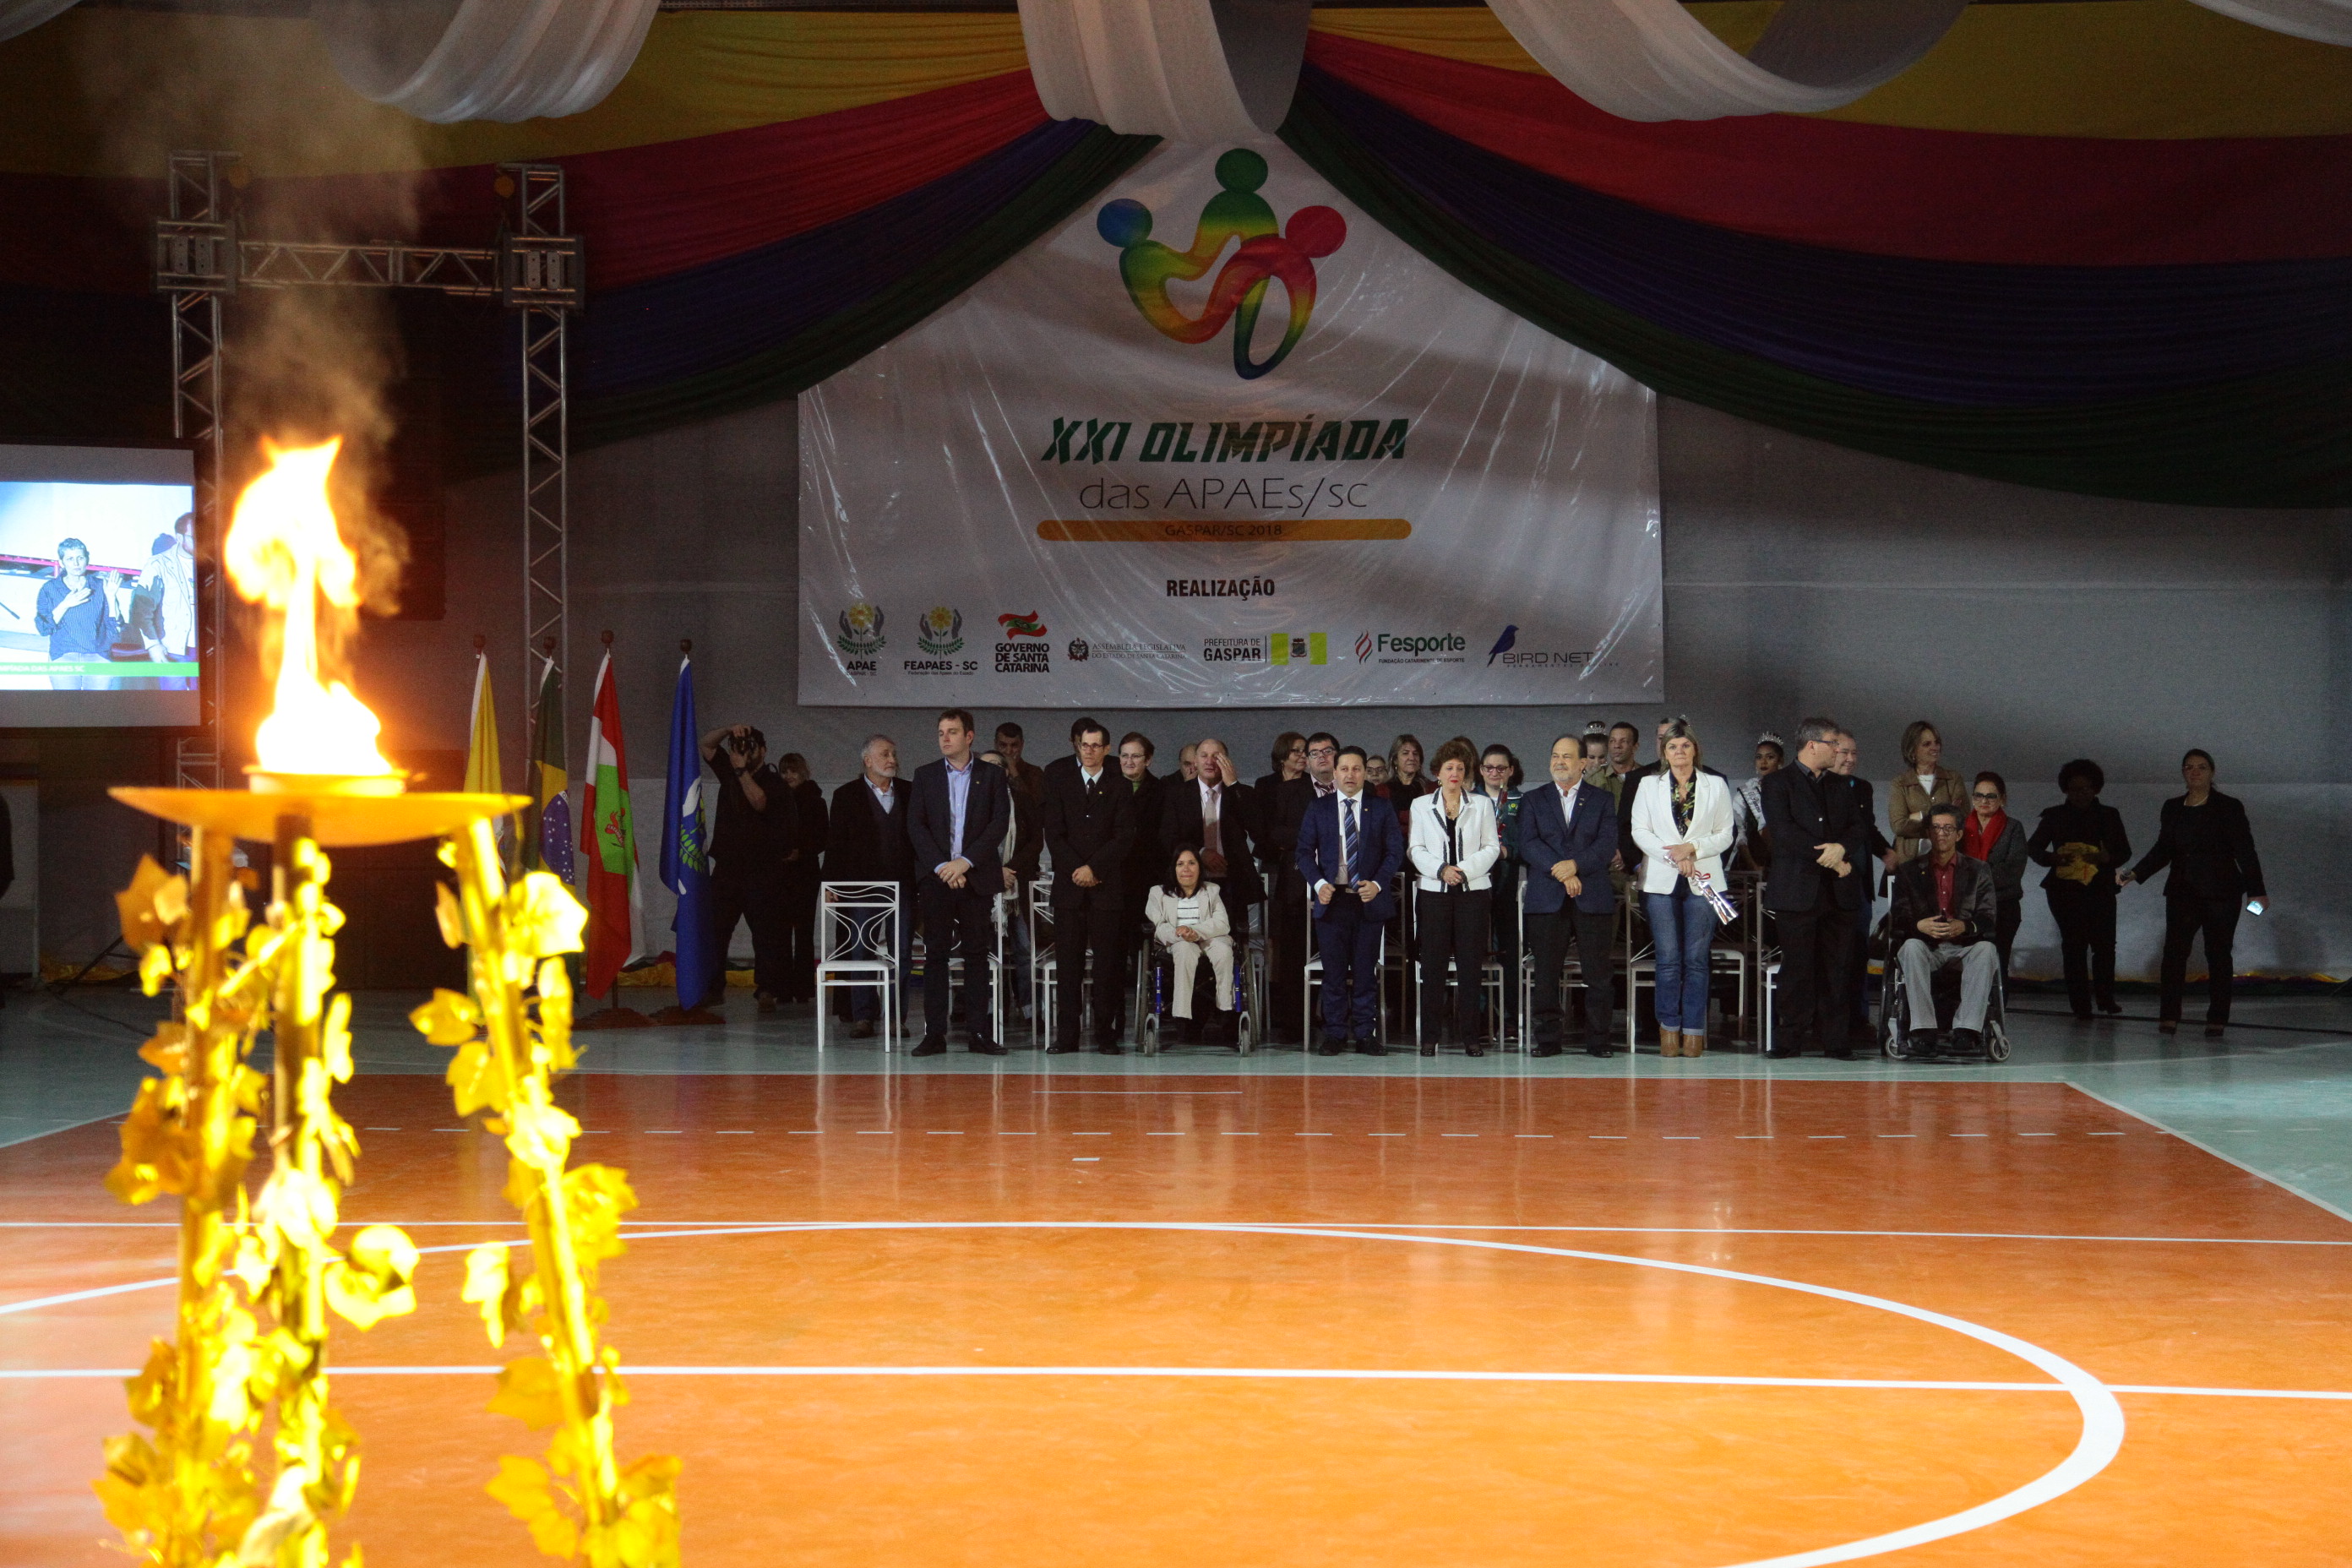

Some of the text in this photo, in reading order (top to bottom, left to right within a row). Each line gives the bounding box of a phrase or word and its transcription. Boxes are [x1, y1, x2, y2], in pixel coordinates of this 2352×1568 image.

[1041, 414, 1409, 465] XXI OLIMPÍADA
[1080, 477, 1368, 517] das APAEs/sc
[1165, 524, 1282, 536] GASPAR/SC 2018
[1167, 576, 1275, 601] REALIZAÇÃO
[995, 643, 1049, 653] GOVERNO
[1378, 633, 1466, 656] Fesporte
[995, 653, 1049, 662] DE SANTA
[1204, 648, 1261, 662] GASPAR
[1503, 652, 1593, 663] BIRD NET
[847, 661, 877, 671] APAE
[904, 661, 953, 671] FEAPAES
[962, 661, 978, 671] SC
[994, 663, 1050, 672] CATARINA
